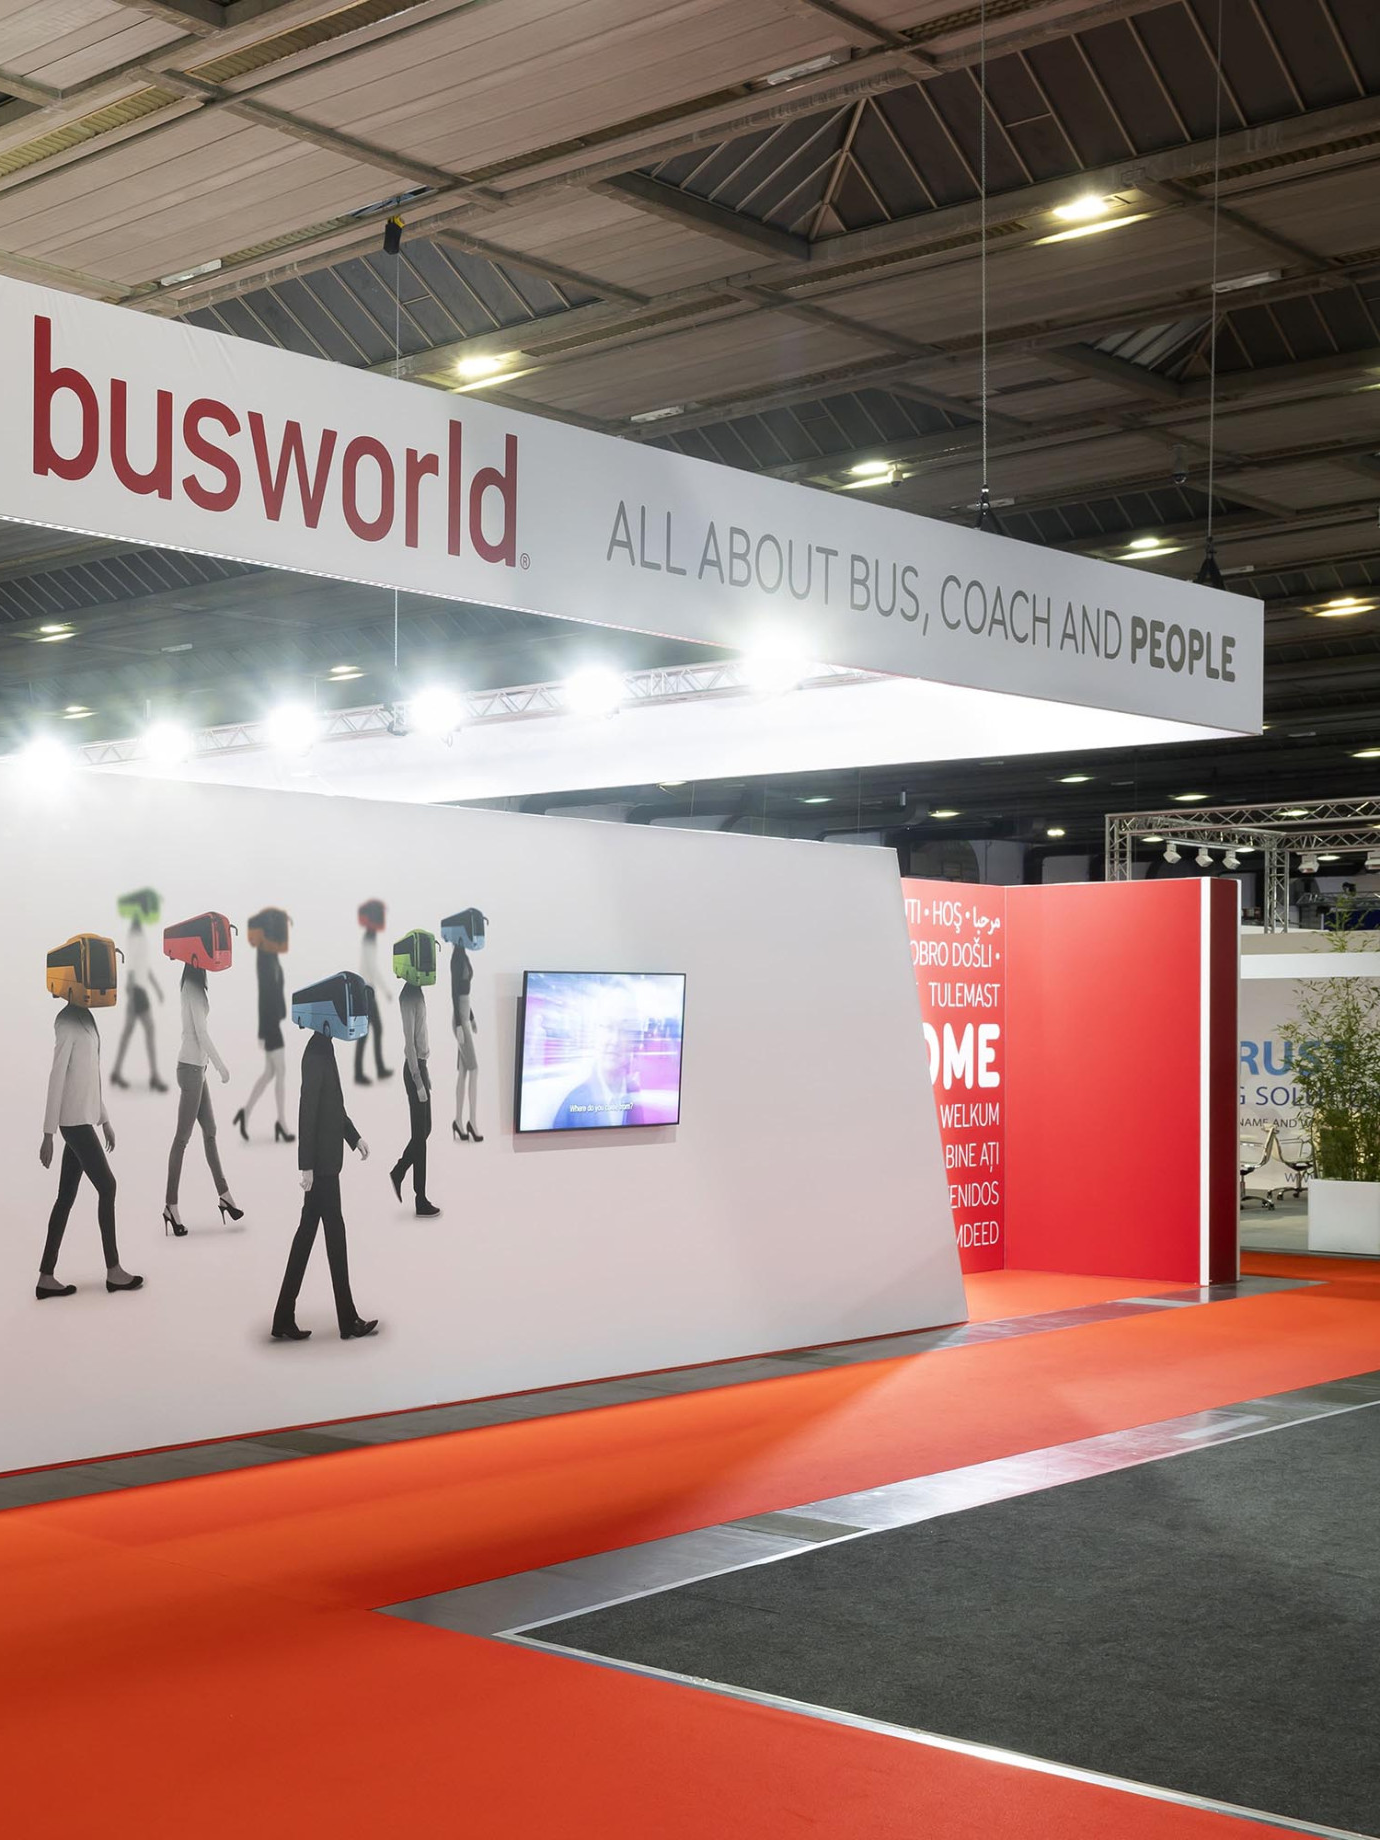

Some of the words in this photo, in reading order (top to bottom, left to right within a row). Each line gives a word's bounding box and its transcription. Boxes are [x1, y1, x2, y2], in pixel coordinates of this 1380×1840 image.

[606, 500, 687, 575] ALL
[698, 521, 839, 606] ABOUT
[850, 554, 930, 636] BUS,
[941, 574, 1051, 649] COACH
[1059, 600, 1122, 660] AND
[1130, 615, 1236, 683] PEOPLE
[952, 937, 992, 968] DOŠLI
[928, 981, 1001, 1008] TULEMAST
[940, 1102, 1000, 1128] WELKUM
[945, 1143, 977, 1169] BINE
[948, 1180, 1000, 1209] ENIDOS
